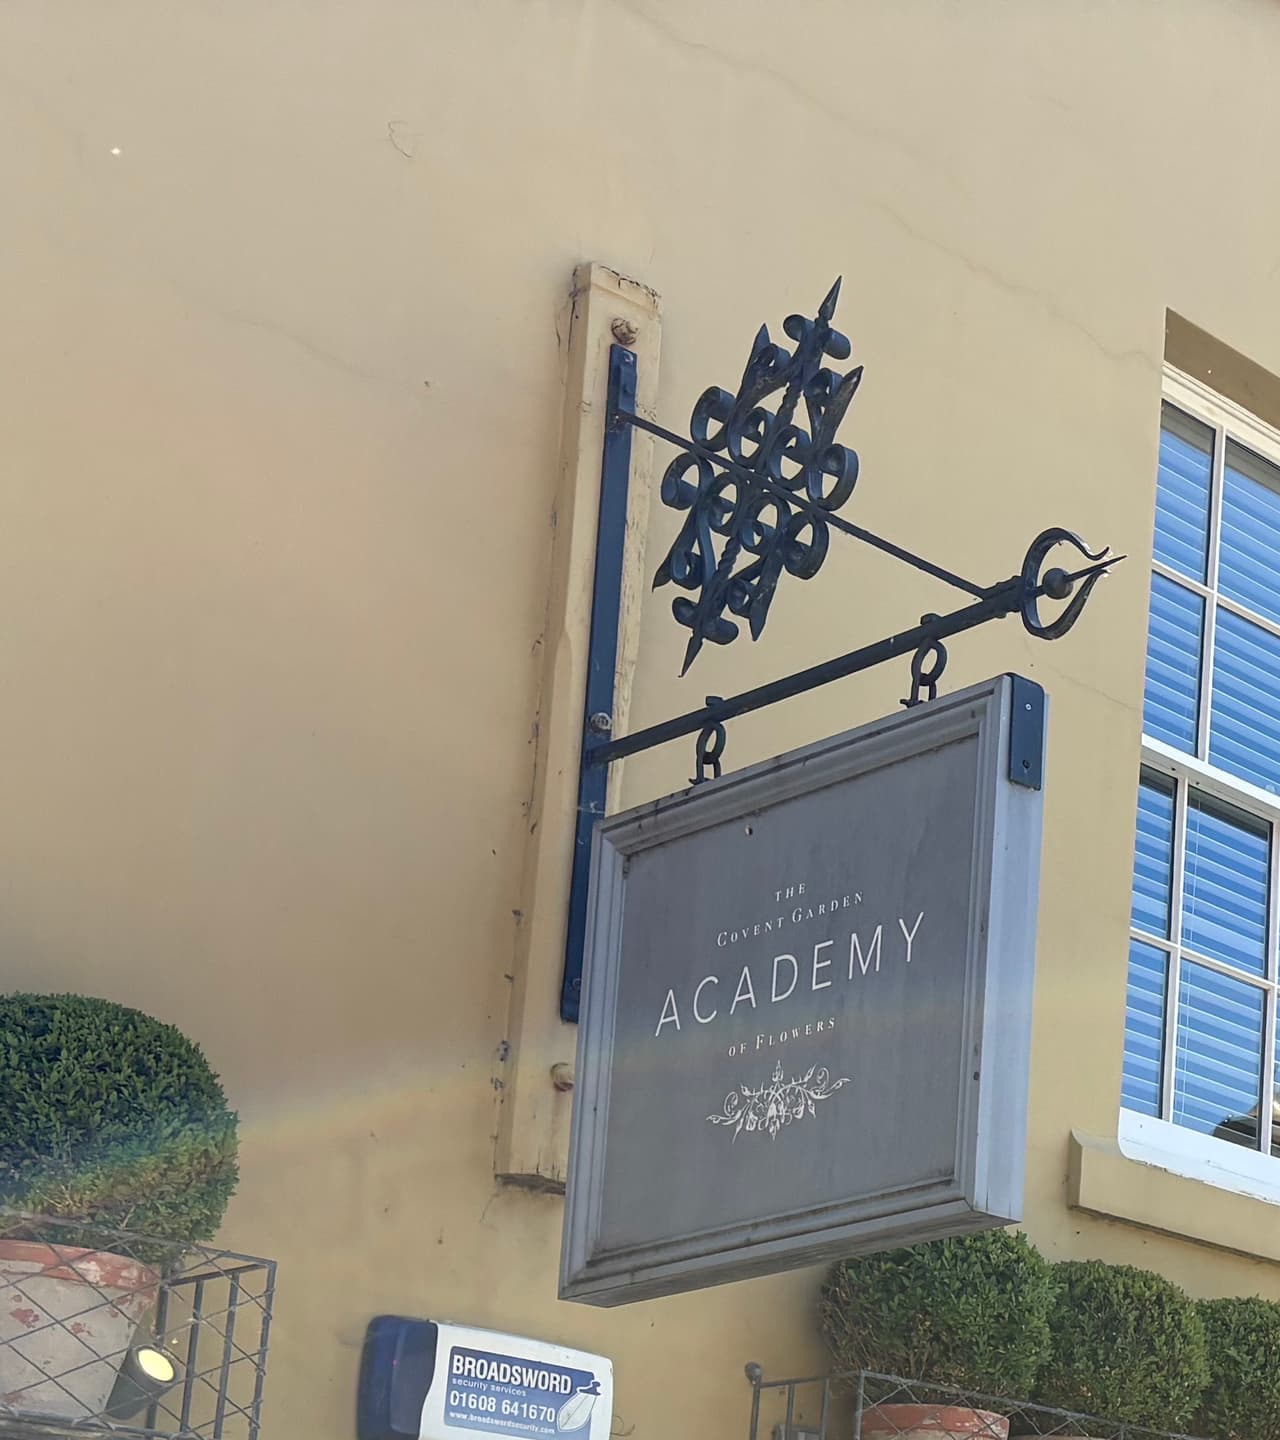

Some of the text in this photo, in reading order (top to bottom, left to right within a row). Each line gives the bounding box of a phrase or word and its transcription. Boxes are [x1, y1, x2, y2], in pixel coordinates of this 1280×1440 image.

[776, 883, 806, 902] THE
[717, 891, 864, 947] COVENT GARDEN
[655, 911, 924, 1037] ACADEMY
[728, 1017, 836, 1057] OF FLOWERS
[452, 1354, 572, 1394] BROADSWORD
[452, 1377, 527, 1397] security services
[450, 1390, 555, 1423] 01608 641670
